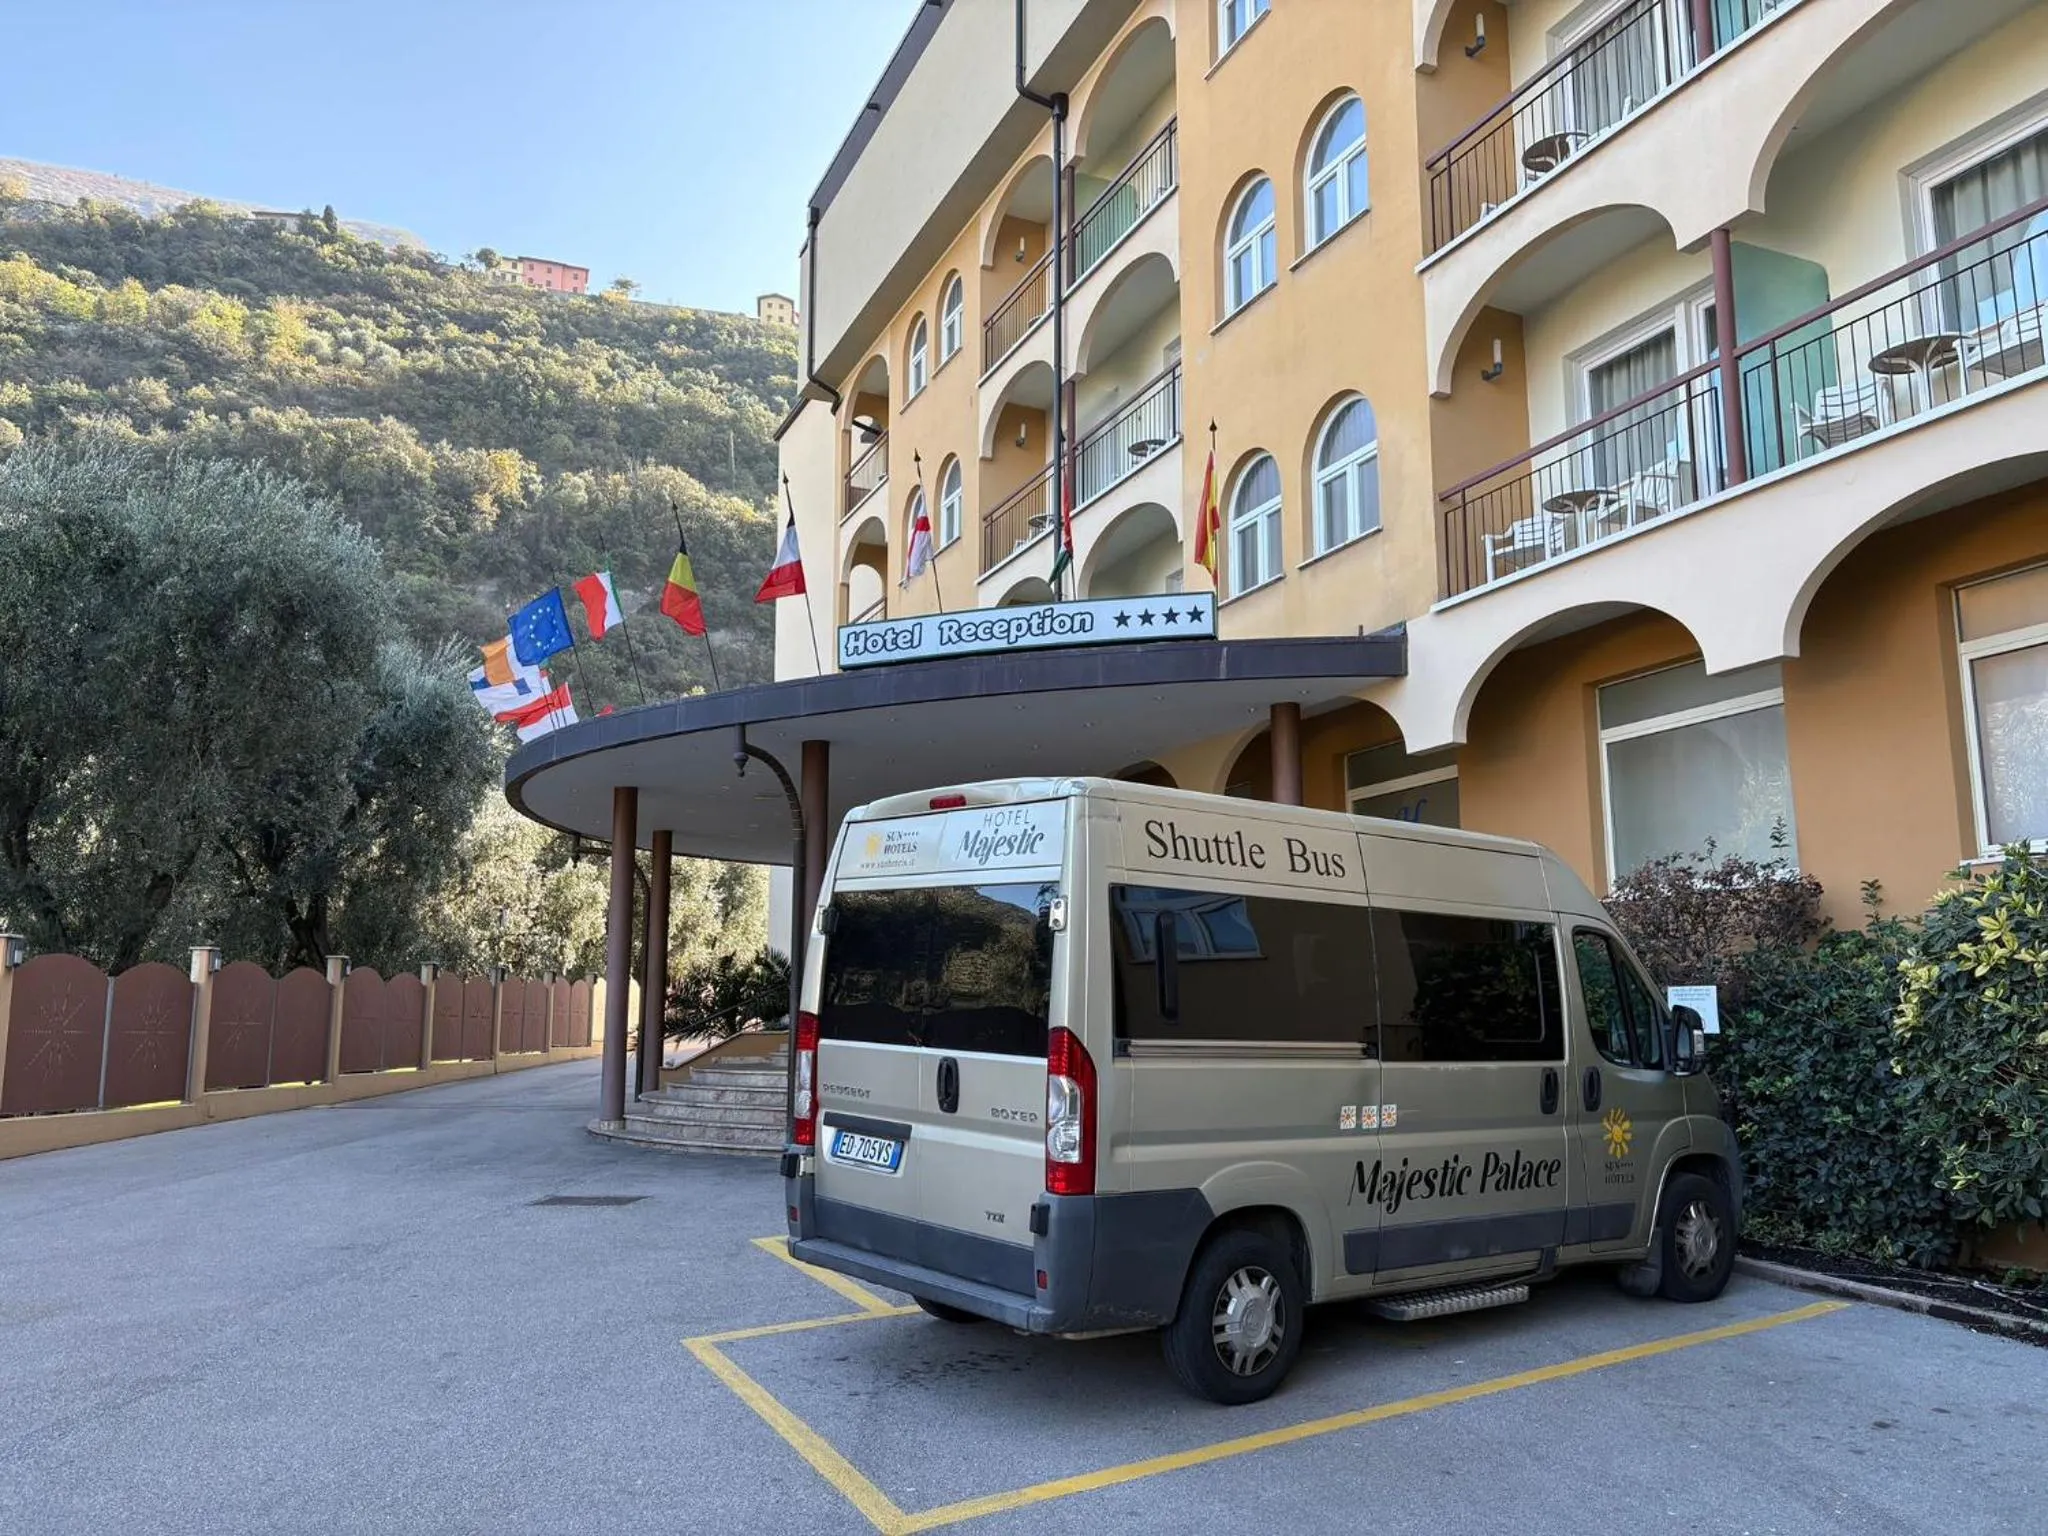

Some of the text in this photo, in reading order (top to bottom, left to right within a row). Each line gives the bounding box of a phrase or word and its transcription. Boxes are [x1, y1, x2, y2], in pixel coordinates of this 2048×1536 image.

[845, 607, 1094, 657] Hotel Reception
[983, 808, 1030, 828] HOTEL
[883, 841, 918, 855] HOTELS
[955, 824, 1045, 866] Majestic
[1144, 819, 1346, 878] Shuttle Bus
[990, 1107, 1038, 1122] BOXER
[1346, 1149, 1562, 1215] Majestic Palace
